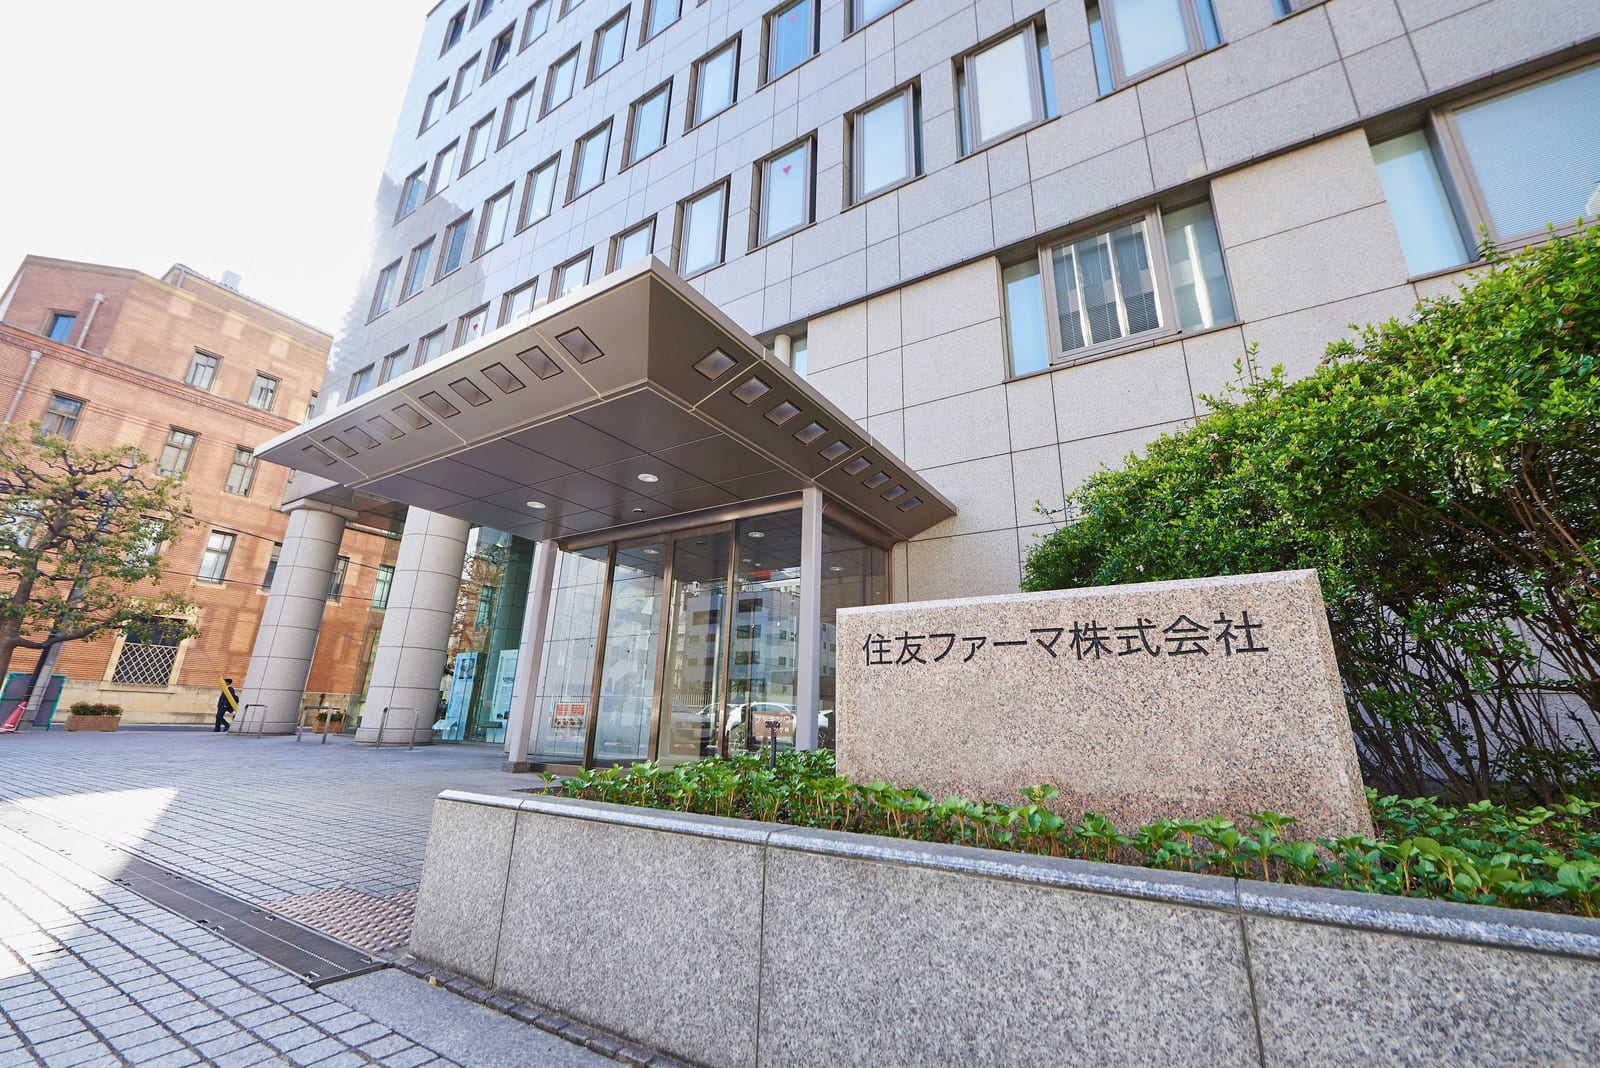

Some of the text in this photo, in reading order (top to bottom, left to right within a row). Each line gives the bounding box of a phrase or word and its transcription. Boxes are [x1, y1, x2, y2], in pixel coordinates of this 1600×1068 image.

[862, 610, 1269, 666] 住友ファーマ株式会社
